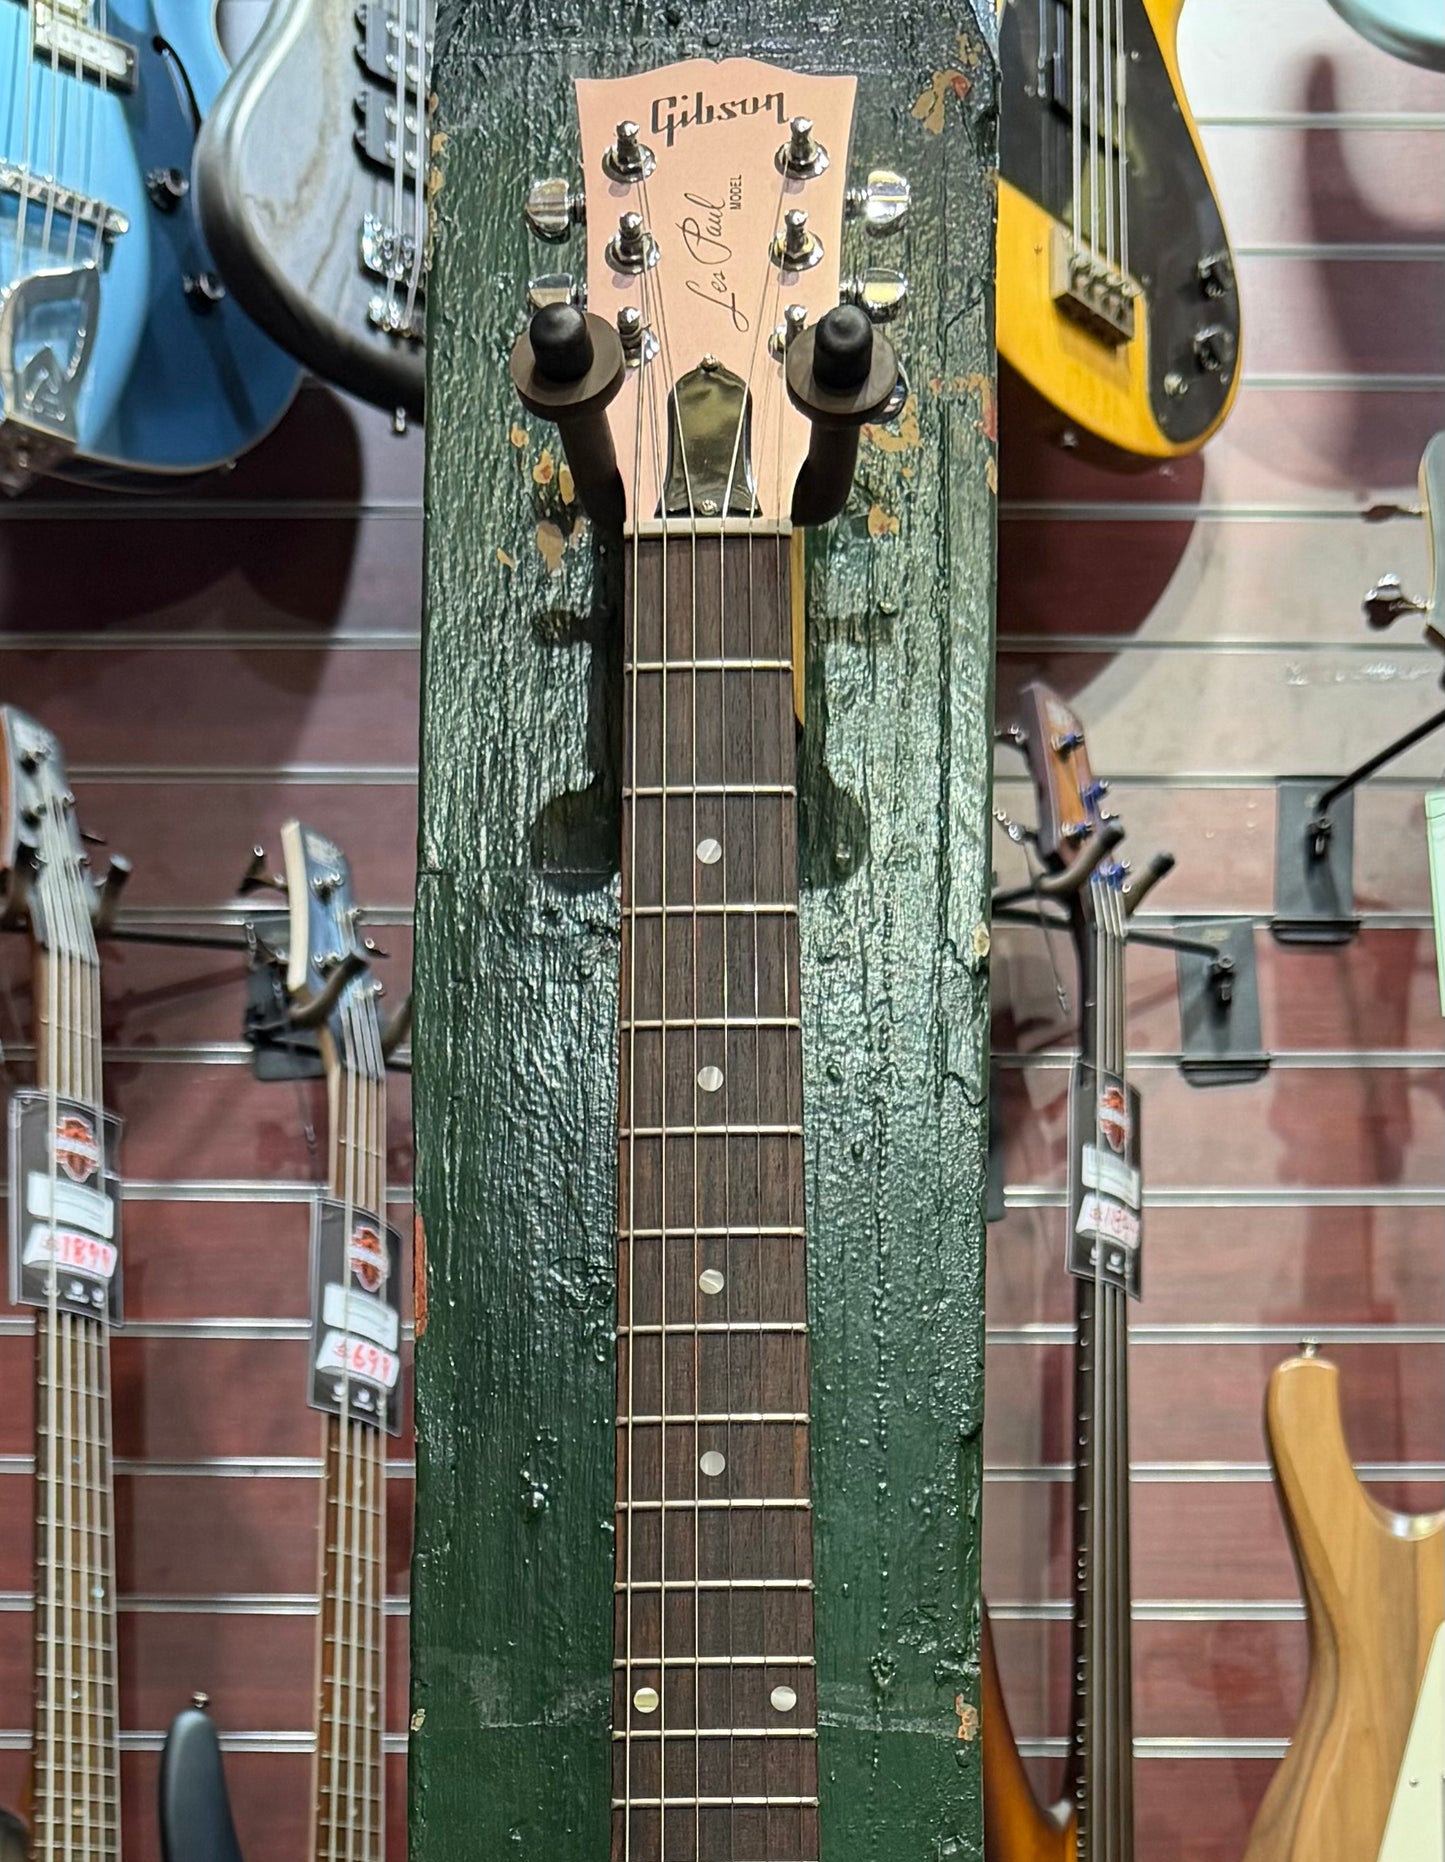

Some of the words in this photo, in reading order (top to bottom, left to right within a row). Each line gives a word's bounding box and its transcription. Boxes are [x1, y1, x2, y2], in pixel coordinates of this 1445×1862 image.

[652, 92, 789, 147] Gibson
[730, 174, 742, 210] MODEL
[675, 192, 732, 265] Paul
[685, 270, 749, 332] Les
